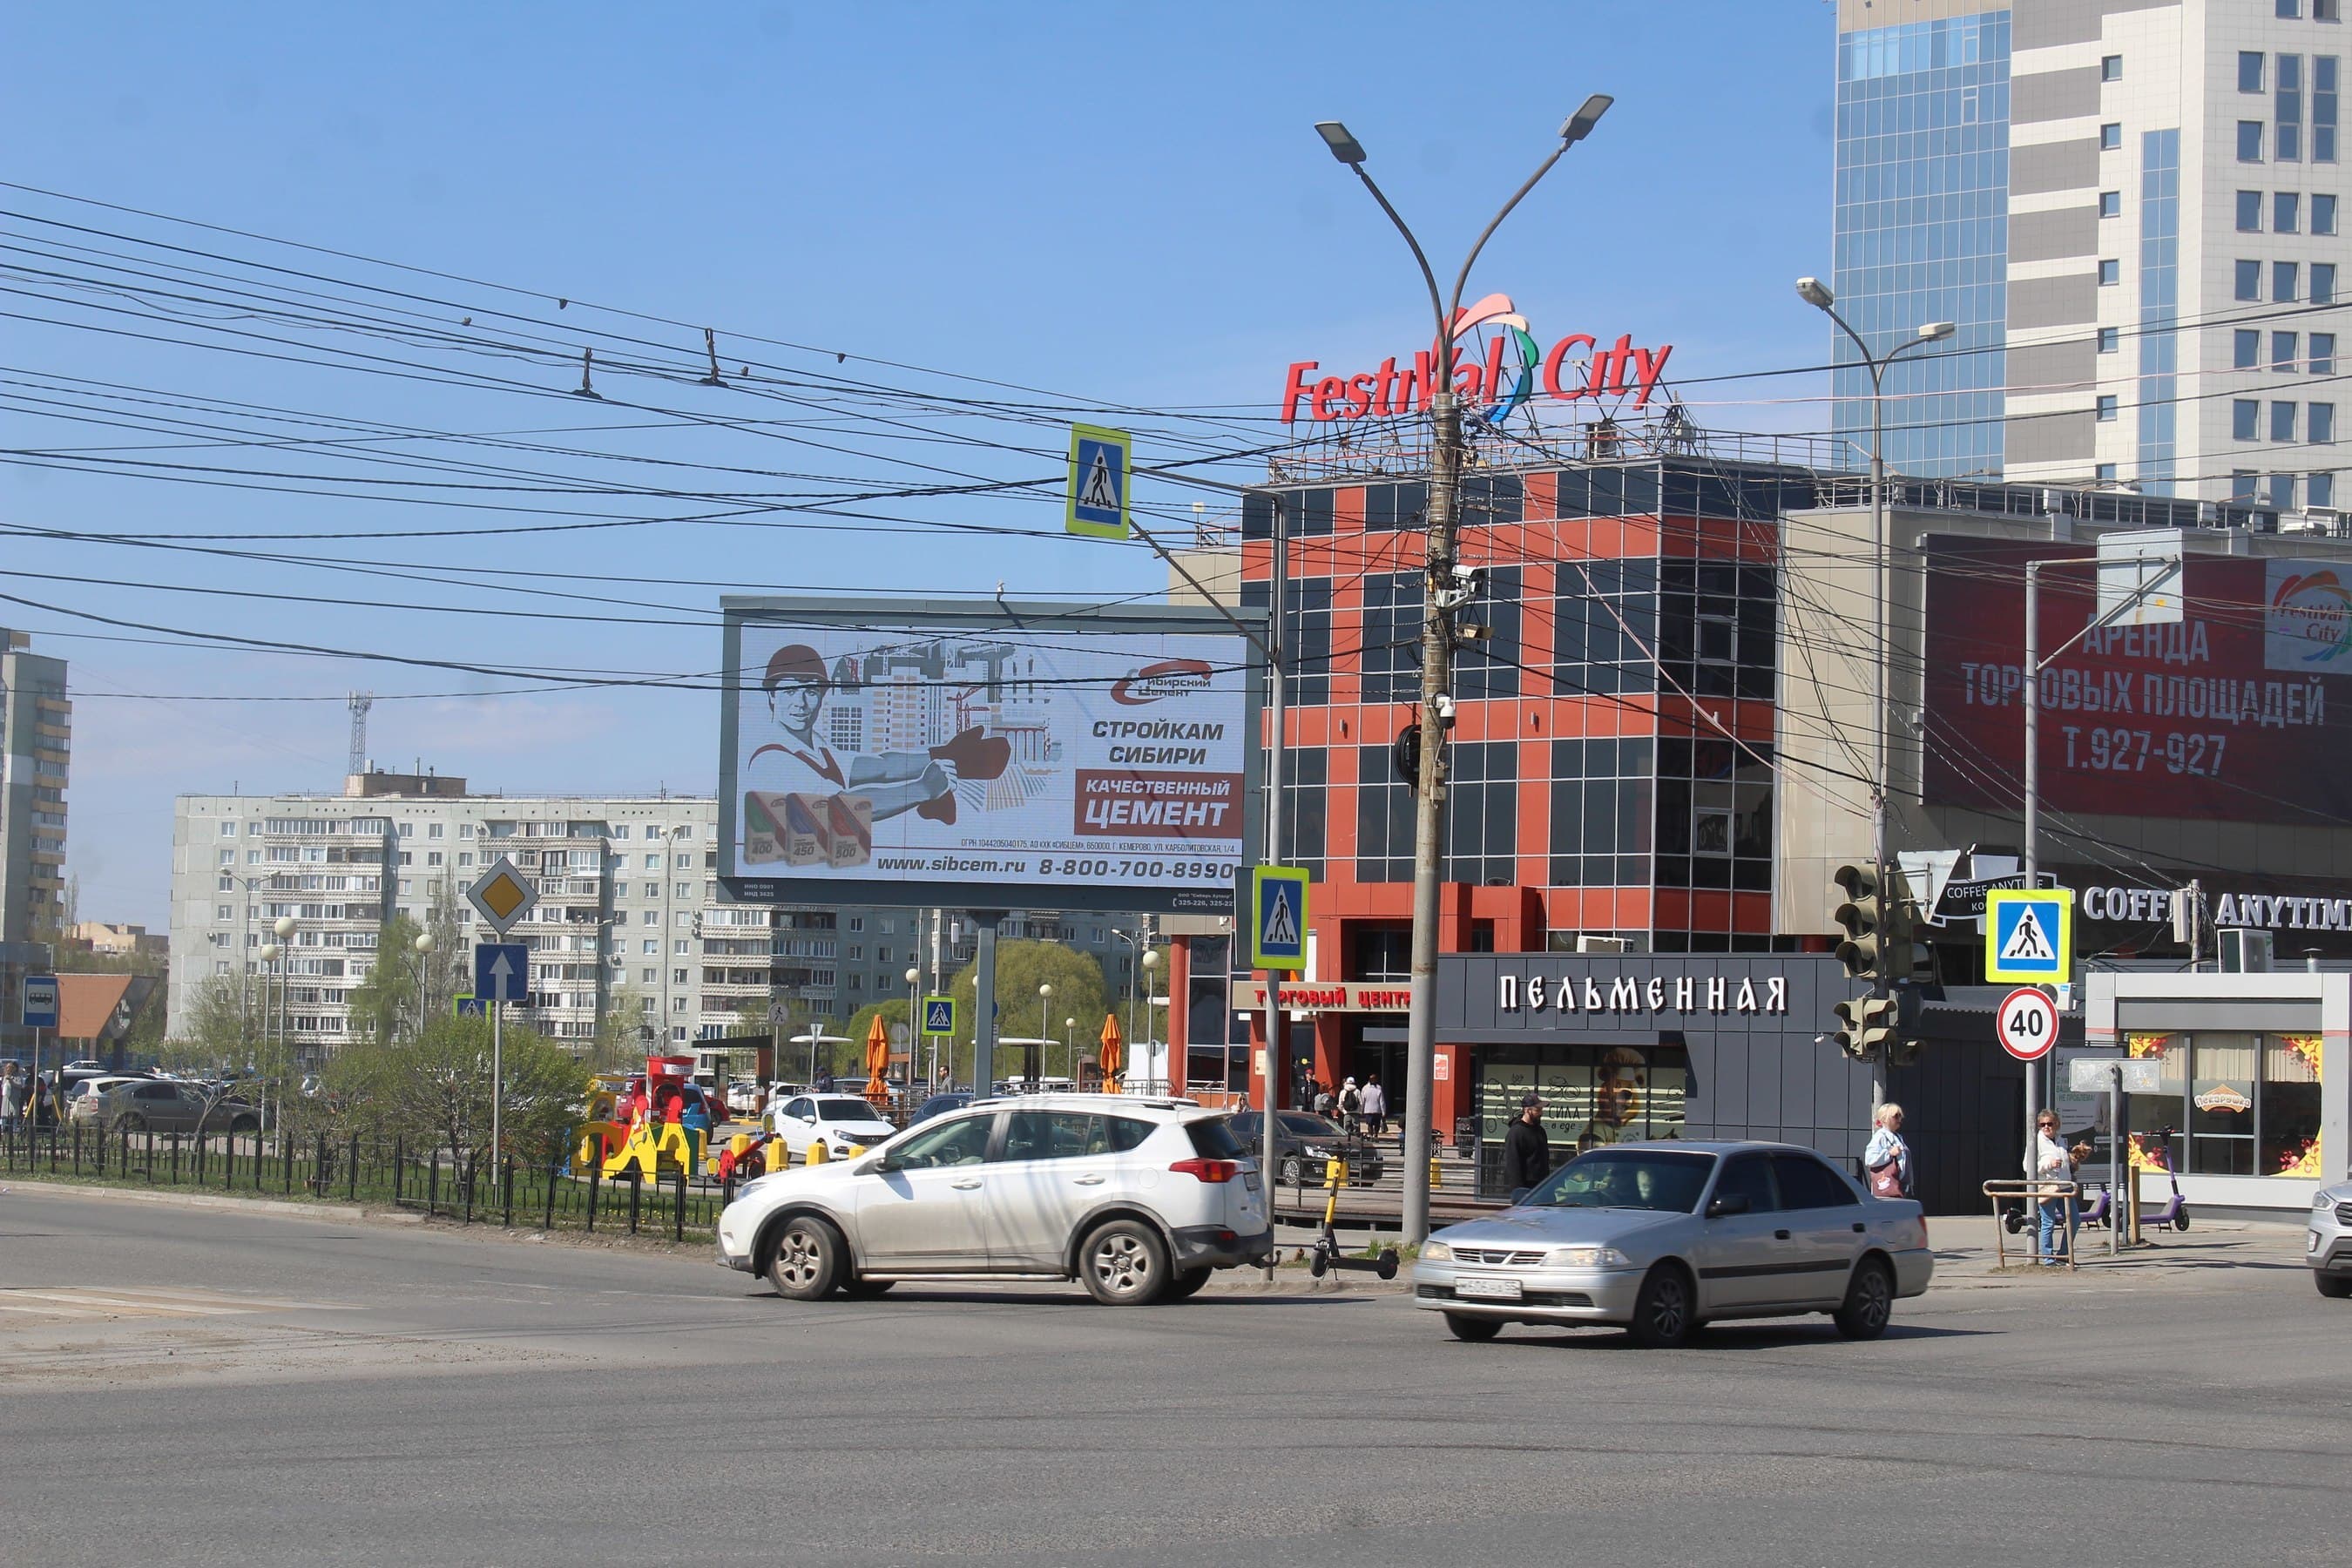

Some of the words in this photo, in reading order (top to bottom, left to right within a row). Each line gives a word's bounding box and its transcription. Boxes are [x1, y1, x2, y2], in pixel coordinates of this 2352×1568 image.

[1543, 334, 1673, 410] City
[2082, 612, 2210, 666] АРЕНДА
[2306, 623, 2342, 643] City
[1961, 662, 2133, 714] ТОРОВЫХ
[2143, 672, 2325, 729] ПЛОЩАДЕЙ
[1092, 718, 1225, 740] СТРОЙКАМ
[1109, 746, 1207, 765] СИБИРИ
[2062, 725, 2227, 776] Т.927-927
[1085, 779, 1231, 796] КАЧЕСТВЕННЫЙ
[1085, 799, 1230, 829] ЦЕМЕНТ
[752, 844, 773, 855] 400
[794, 846, 815, 856] 450
[835, 848, 857, 859] 500
[961, 839, 977, 848] ОГРН
[877, 856, 1026, 873] www.sibcem.ru
[1039, 859, 1234, 879] 8-800-700-8990
[1947, 884, 1988, 898] COFFEE
[2214, 892, 2352, 931] ANYTIM
[1254, 987, 1348, 1007] ТРГОВЫЙ
[1500, 975, 1786, 1011] ПЕЛЬМЕННАЯ
[2010, 1009, 2043, 1037] 40
[1548, 1105, 1581, 1120] СИЛА
